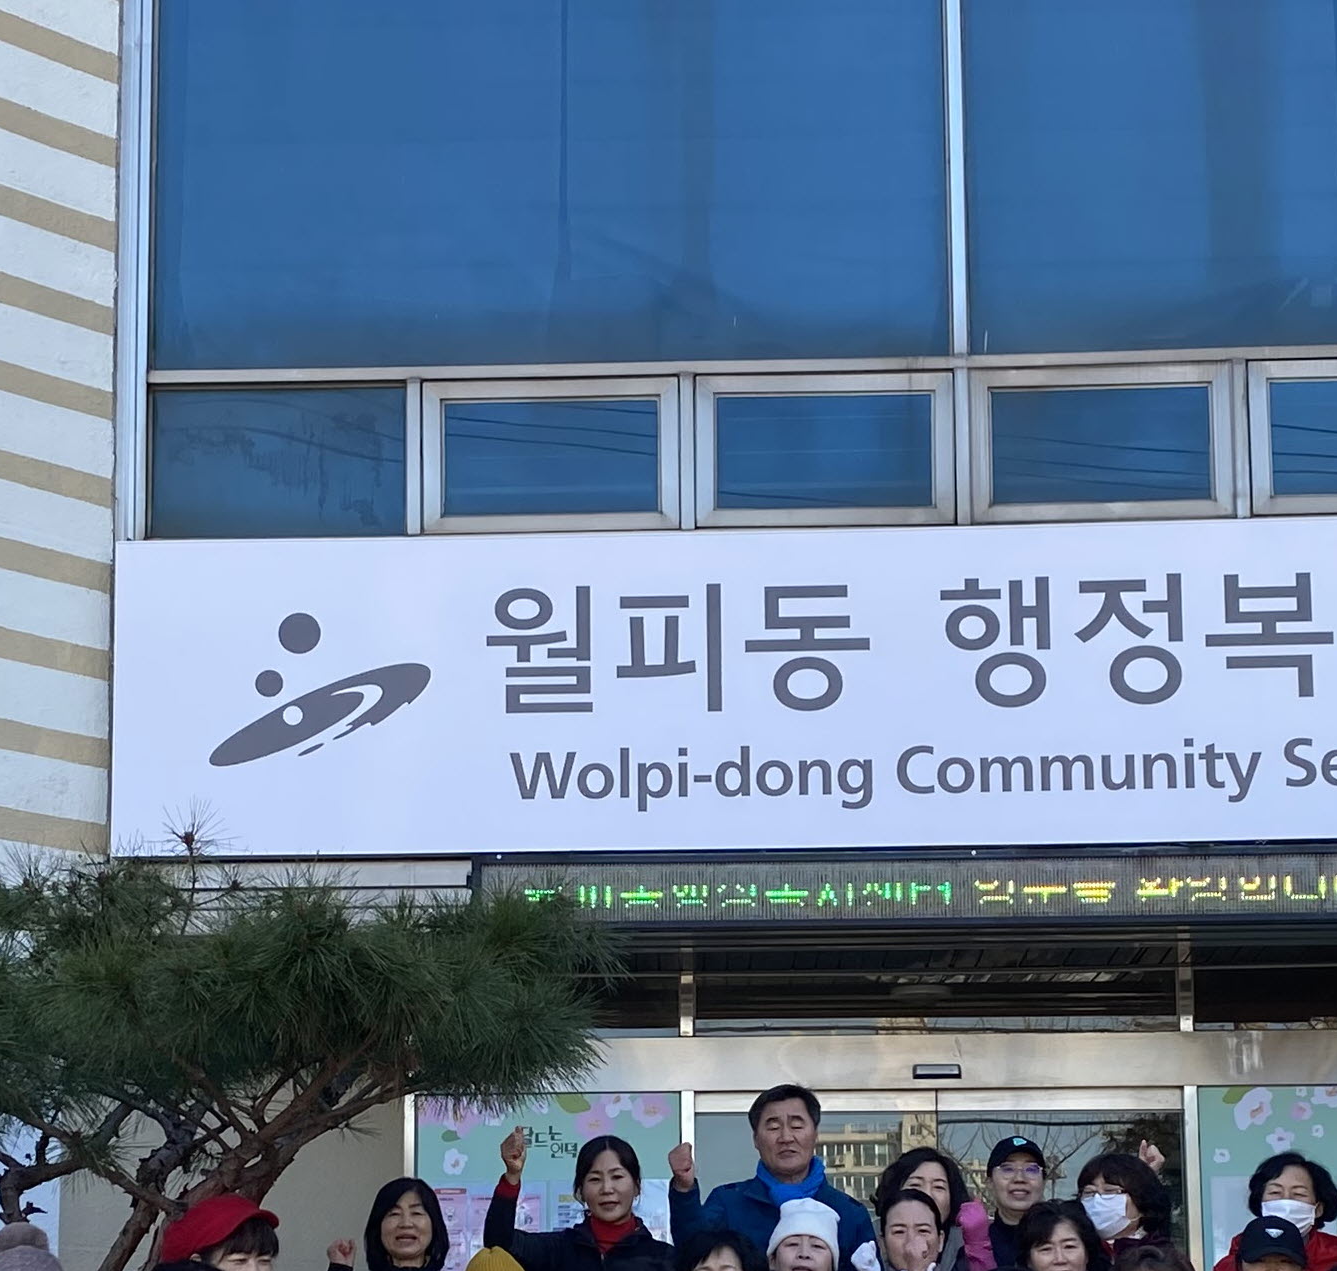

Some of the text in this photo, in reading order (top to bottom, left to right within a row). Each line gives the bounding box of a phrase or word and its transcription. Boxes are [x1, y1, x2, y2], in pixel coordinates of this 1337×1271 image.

[486, 583, 870, 714] 월피동
[509, 745, 873, 812] Wolpi-dong
[895, 737, 1262, 802] Community
